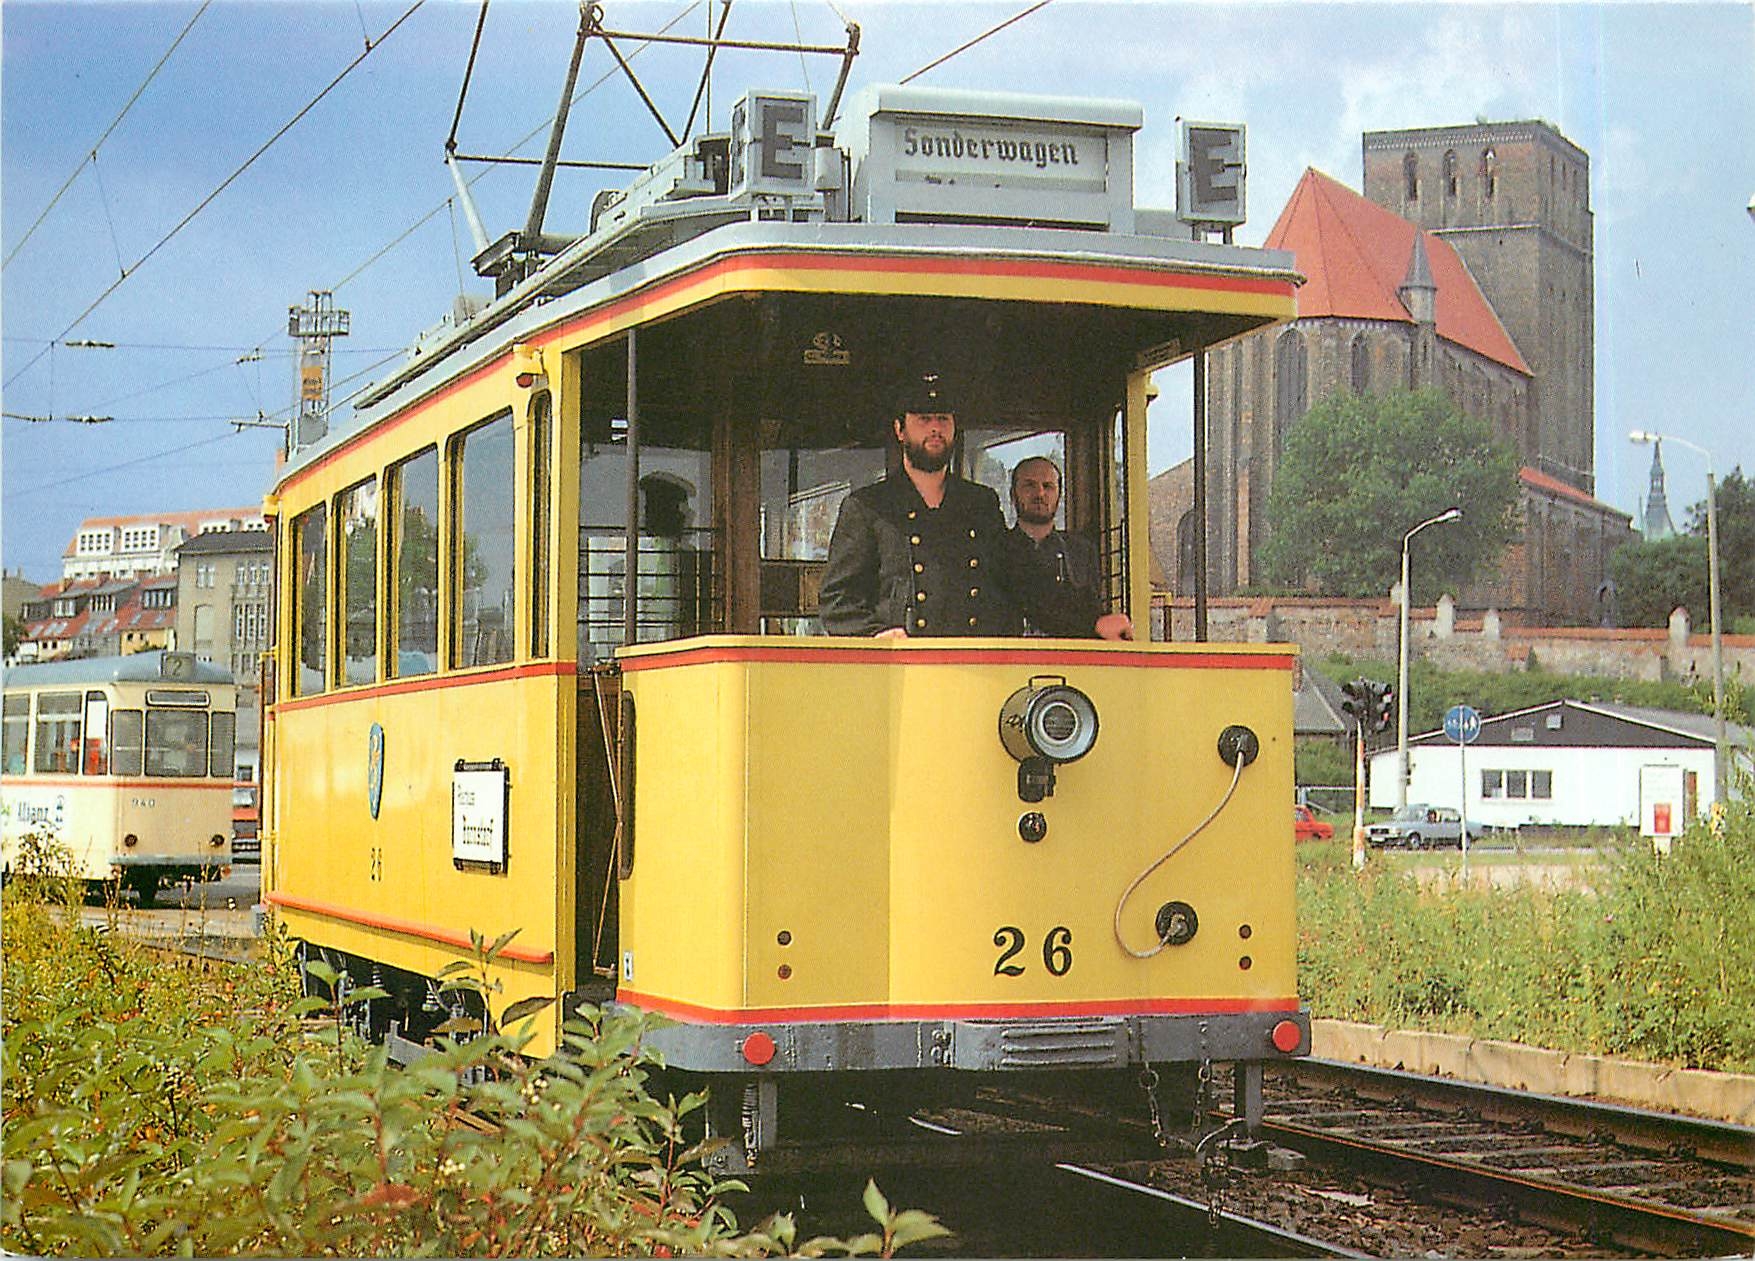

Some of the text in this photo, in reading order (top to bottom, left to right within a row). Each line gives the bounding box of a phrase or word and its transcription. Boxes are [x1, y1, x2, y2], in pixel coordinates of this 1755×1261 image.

[762, 104, 803, 180] E
[904, 126, 1080, 168] Sonderwagen
[1189, 129, 1238, 204] E
[992, 925, 1073, 977] 26
